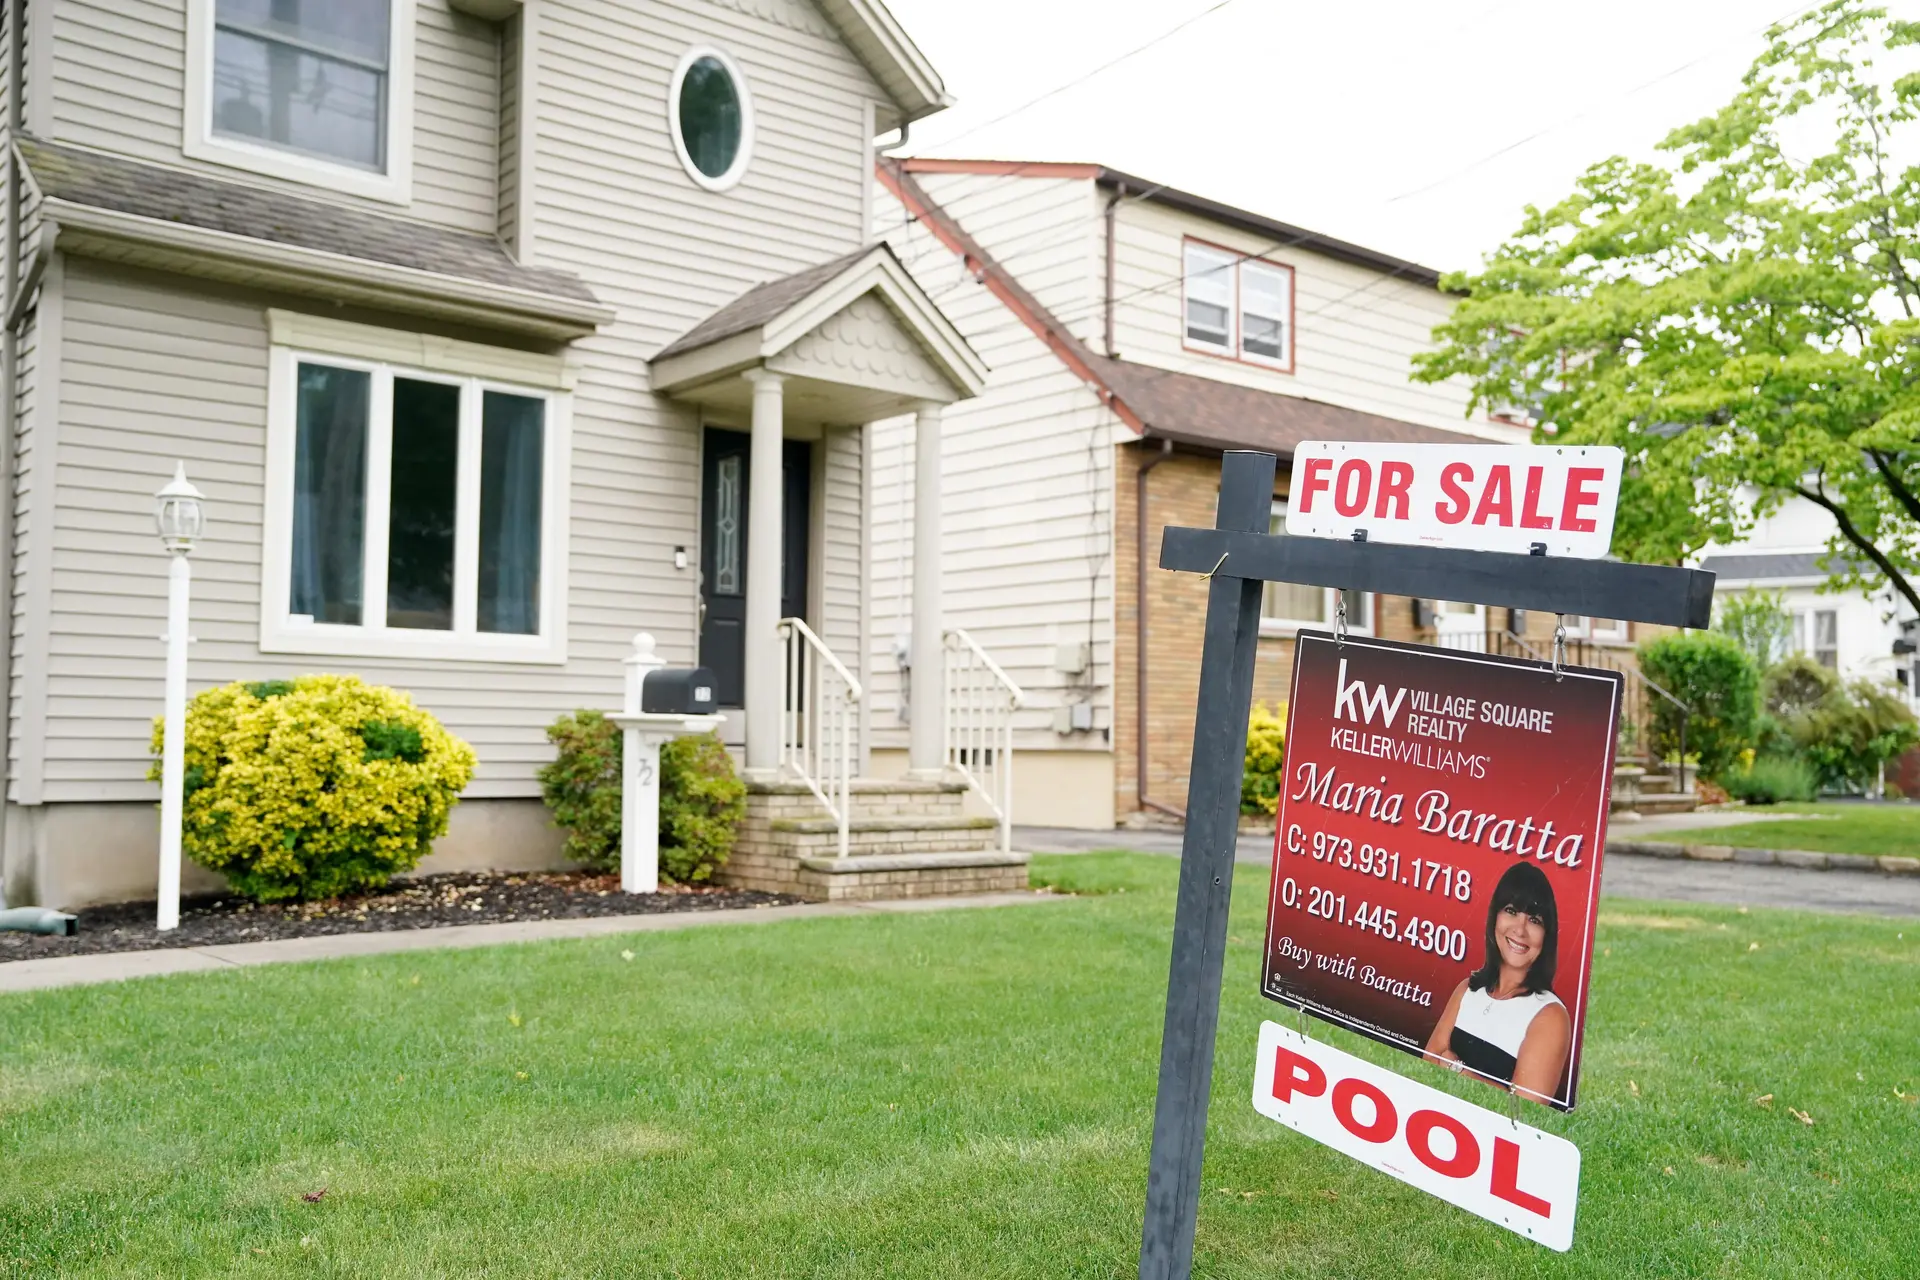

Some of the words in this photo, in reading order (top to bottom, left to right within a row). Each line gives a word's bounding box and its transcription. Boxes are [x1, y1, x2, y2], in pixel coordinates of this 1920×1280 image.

[1299, 458, 1414, 521] FOR
[1435, 462, 1605, 533] SALE
[1407, 713, 1468, 743] REALTY
[1411, 690, 1476, 720] VILLAGE
[1480, 701, 1554, 733] SQUARE
[1292, 762, 1404, 824] Maria
[1415, 789, 1585, 868] Baratta
[1287, 823, 1307, 855] C:
[1312, 831, 1472, 902] 973.931.1718
[1307, 885, 1467, 961] 201.445.4300
[1278, 936, 1312, 969] Buy
[1315, 953, 1356, 980] with
[1359, 965, 1433, 1007] Baratta
[1271, 1045, 1551, 1220] POOL
